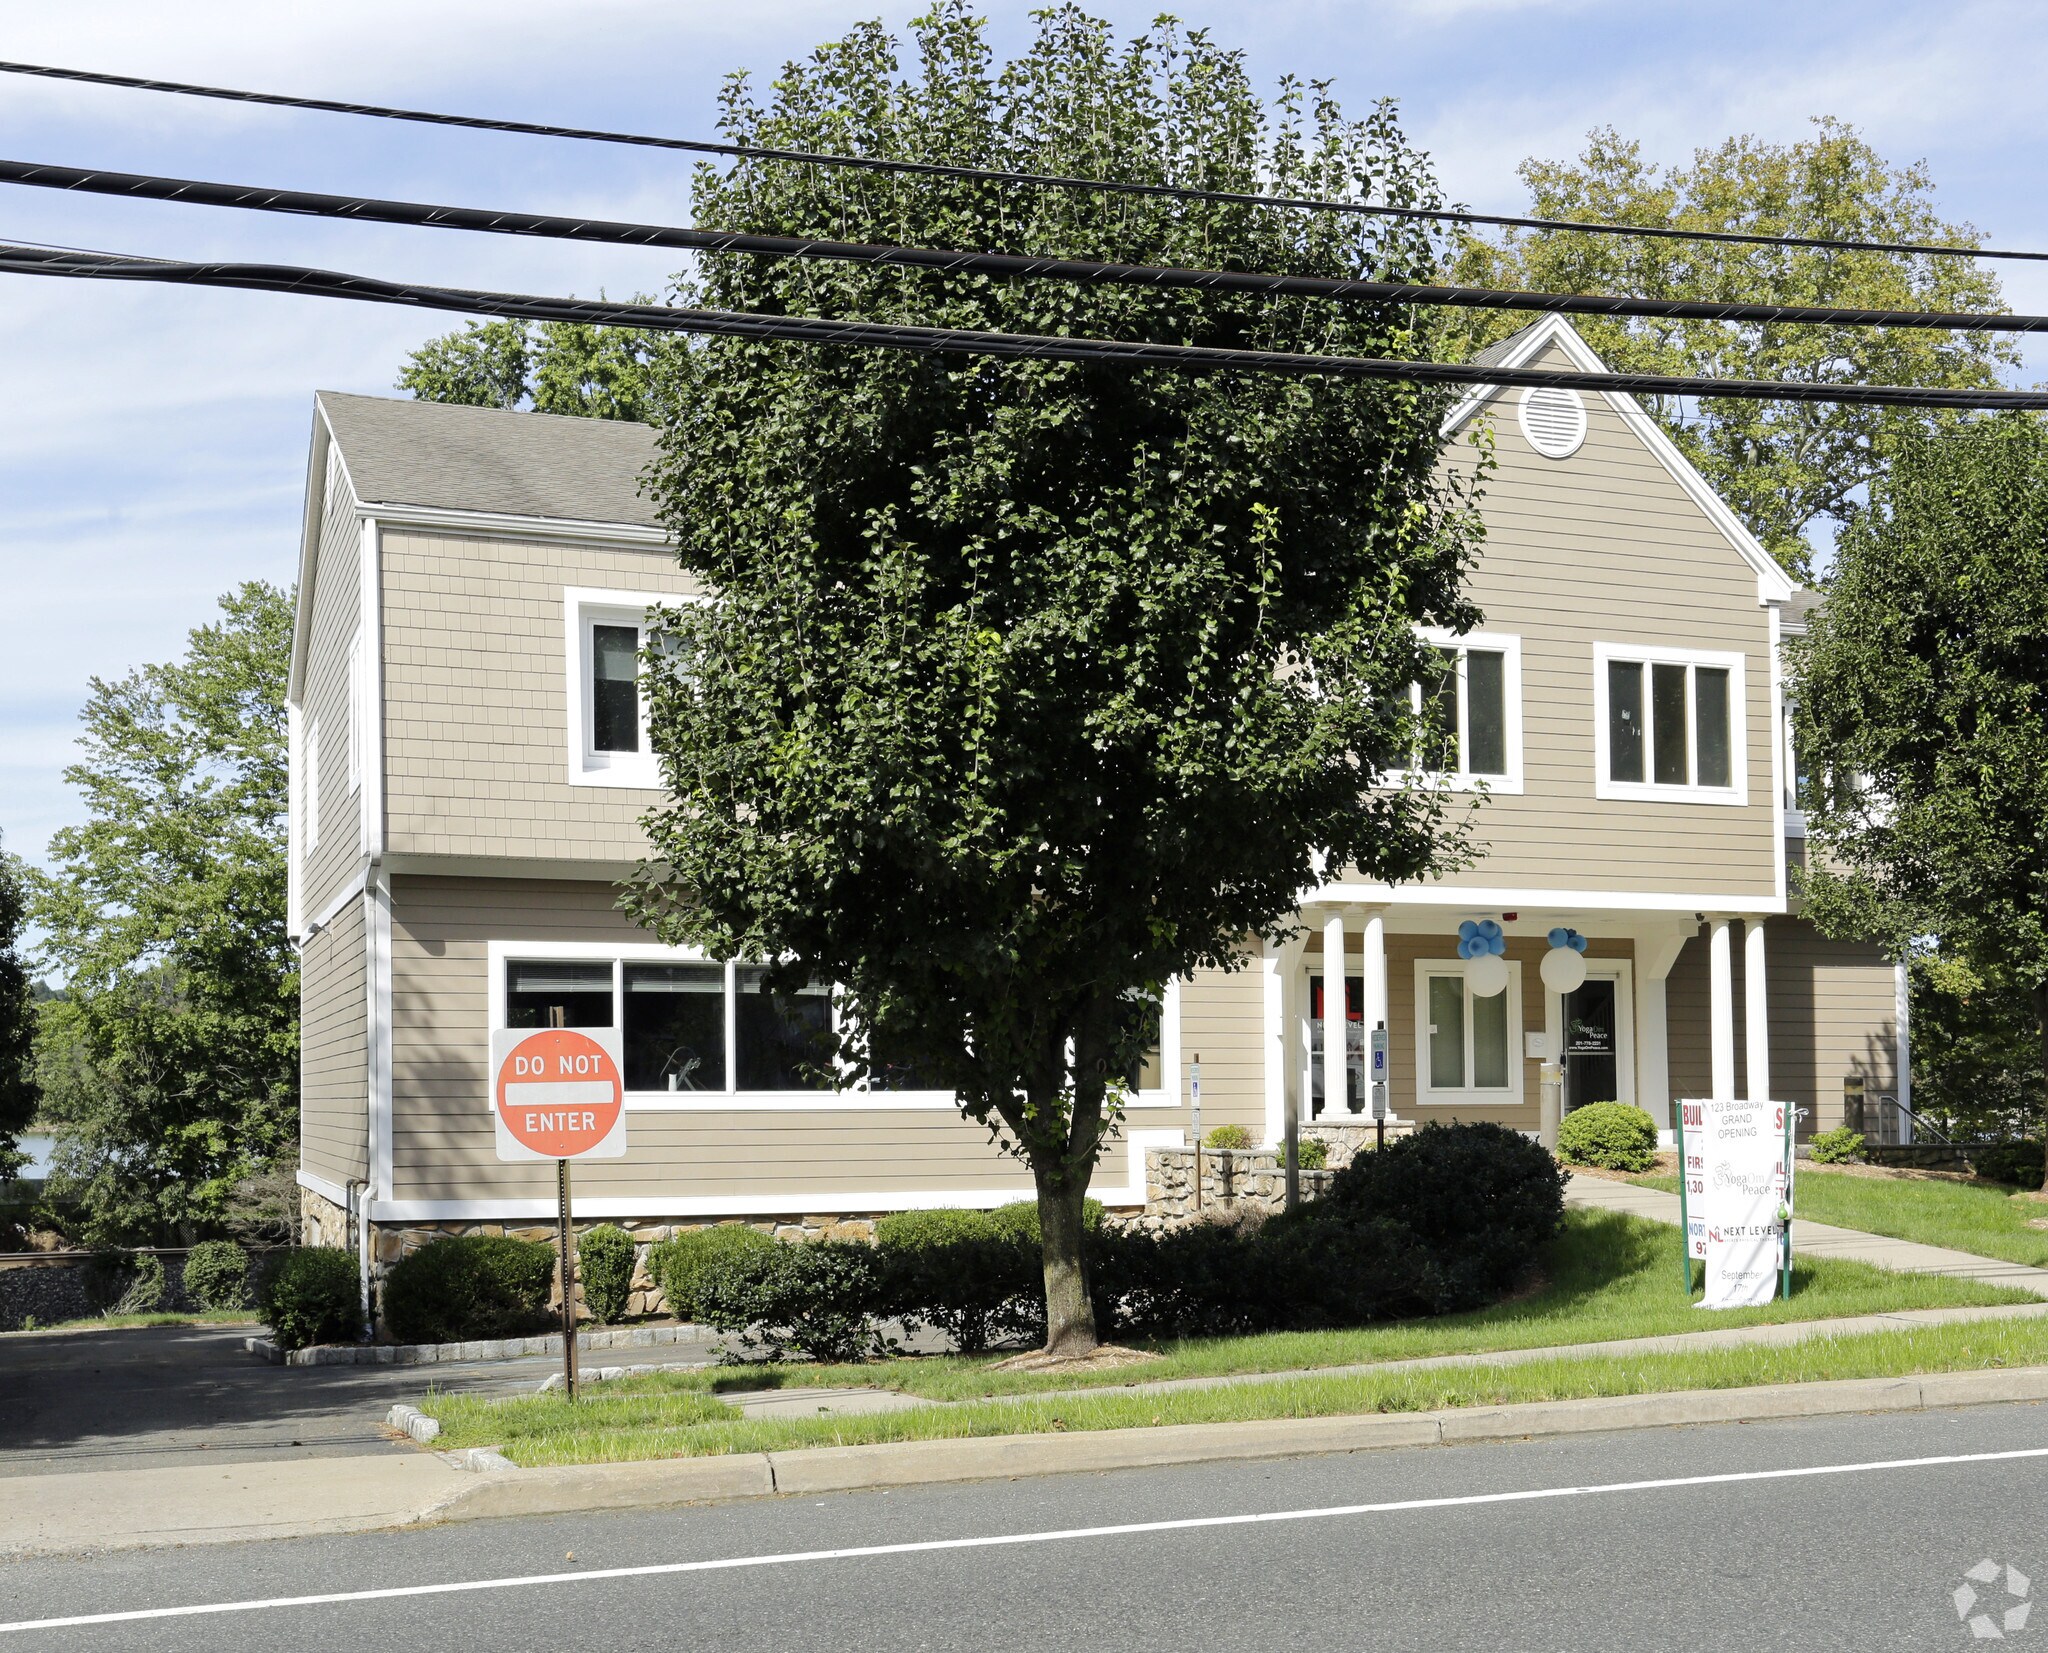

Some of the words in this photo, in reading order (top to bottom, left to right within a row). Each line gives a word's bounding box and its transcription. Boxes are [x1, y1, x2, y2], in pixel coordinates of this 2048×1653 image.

[515, 1056, 545, 1075] DO
[559, 1055, 602, 1075] NOT
[1711, 1103, 1724, 1113] 123
[1726, 1101, 1764, 1111] Broadway
[525, 1112, 596, 1132] ENTER
[1721, 1114, 1753, 1125] GRAND
[1718, 1127, 1758, 1139] OPENING
[1742, 1184, 1771, 1195] Peace
[1724, 1226, 1746, 1236] NEXT
[1750, 1225, 1777, 1236] LEVEL
[1721, 1269, 1764, 1280] September
